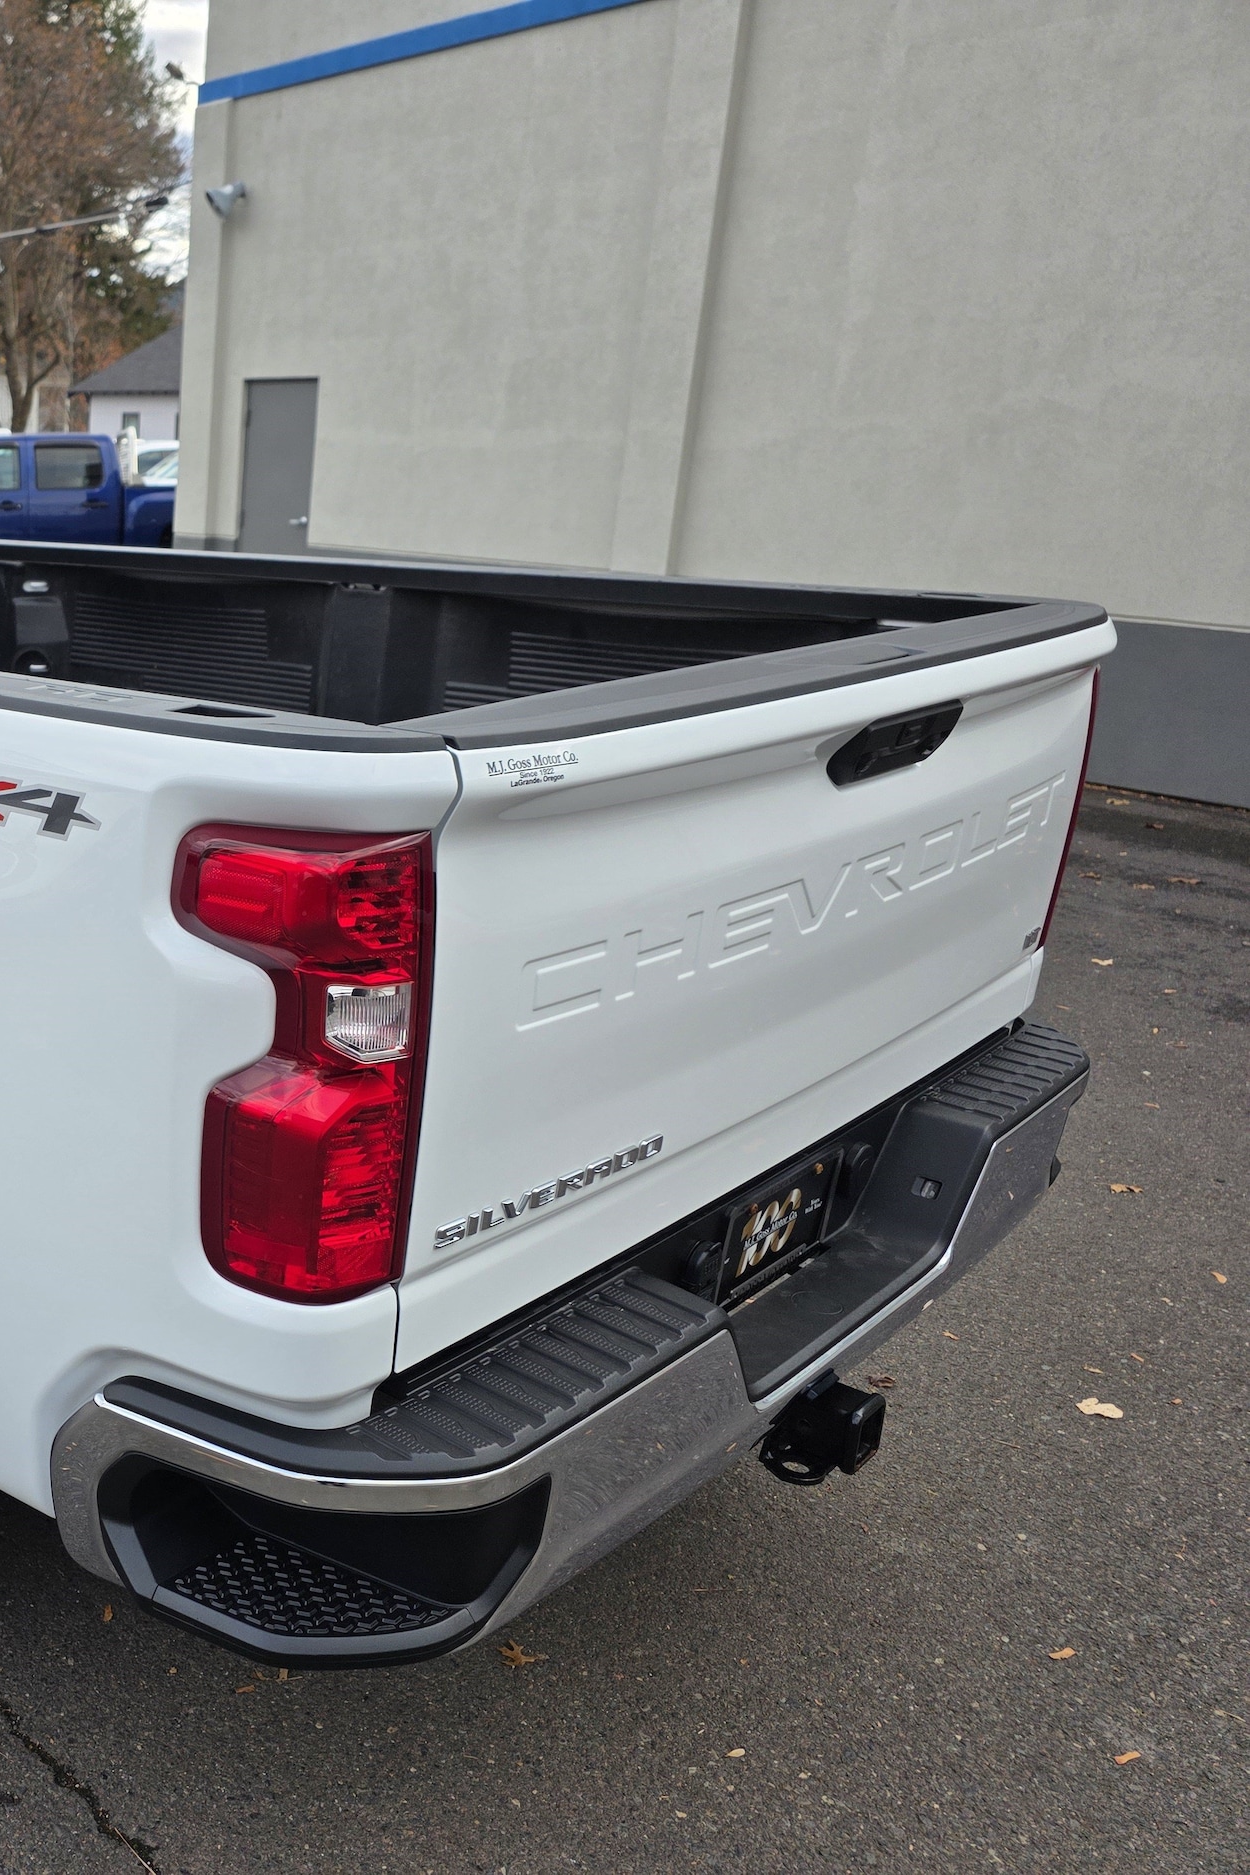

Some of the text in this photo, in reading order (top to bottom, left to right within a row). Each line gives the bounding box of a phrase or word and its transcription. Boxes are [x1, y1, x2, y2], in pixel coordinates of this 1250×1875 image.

[486, 750, 579, 775] M.J. Goss Motor Co.
[519, 767, 555, 779] Since 1922
[543, 773, 565, 783] Oregon
[516, 770, 1067, 1032] CHEVROLET
[432, 1132, 664, 1250] SILVERADO
